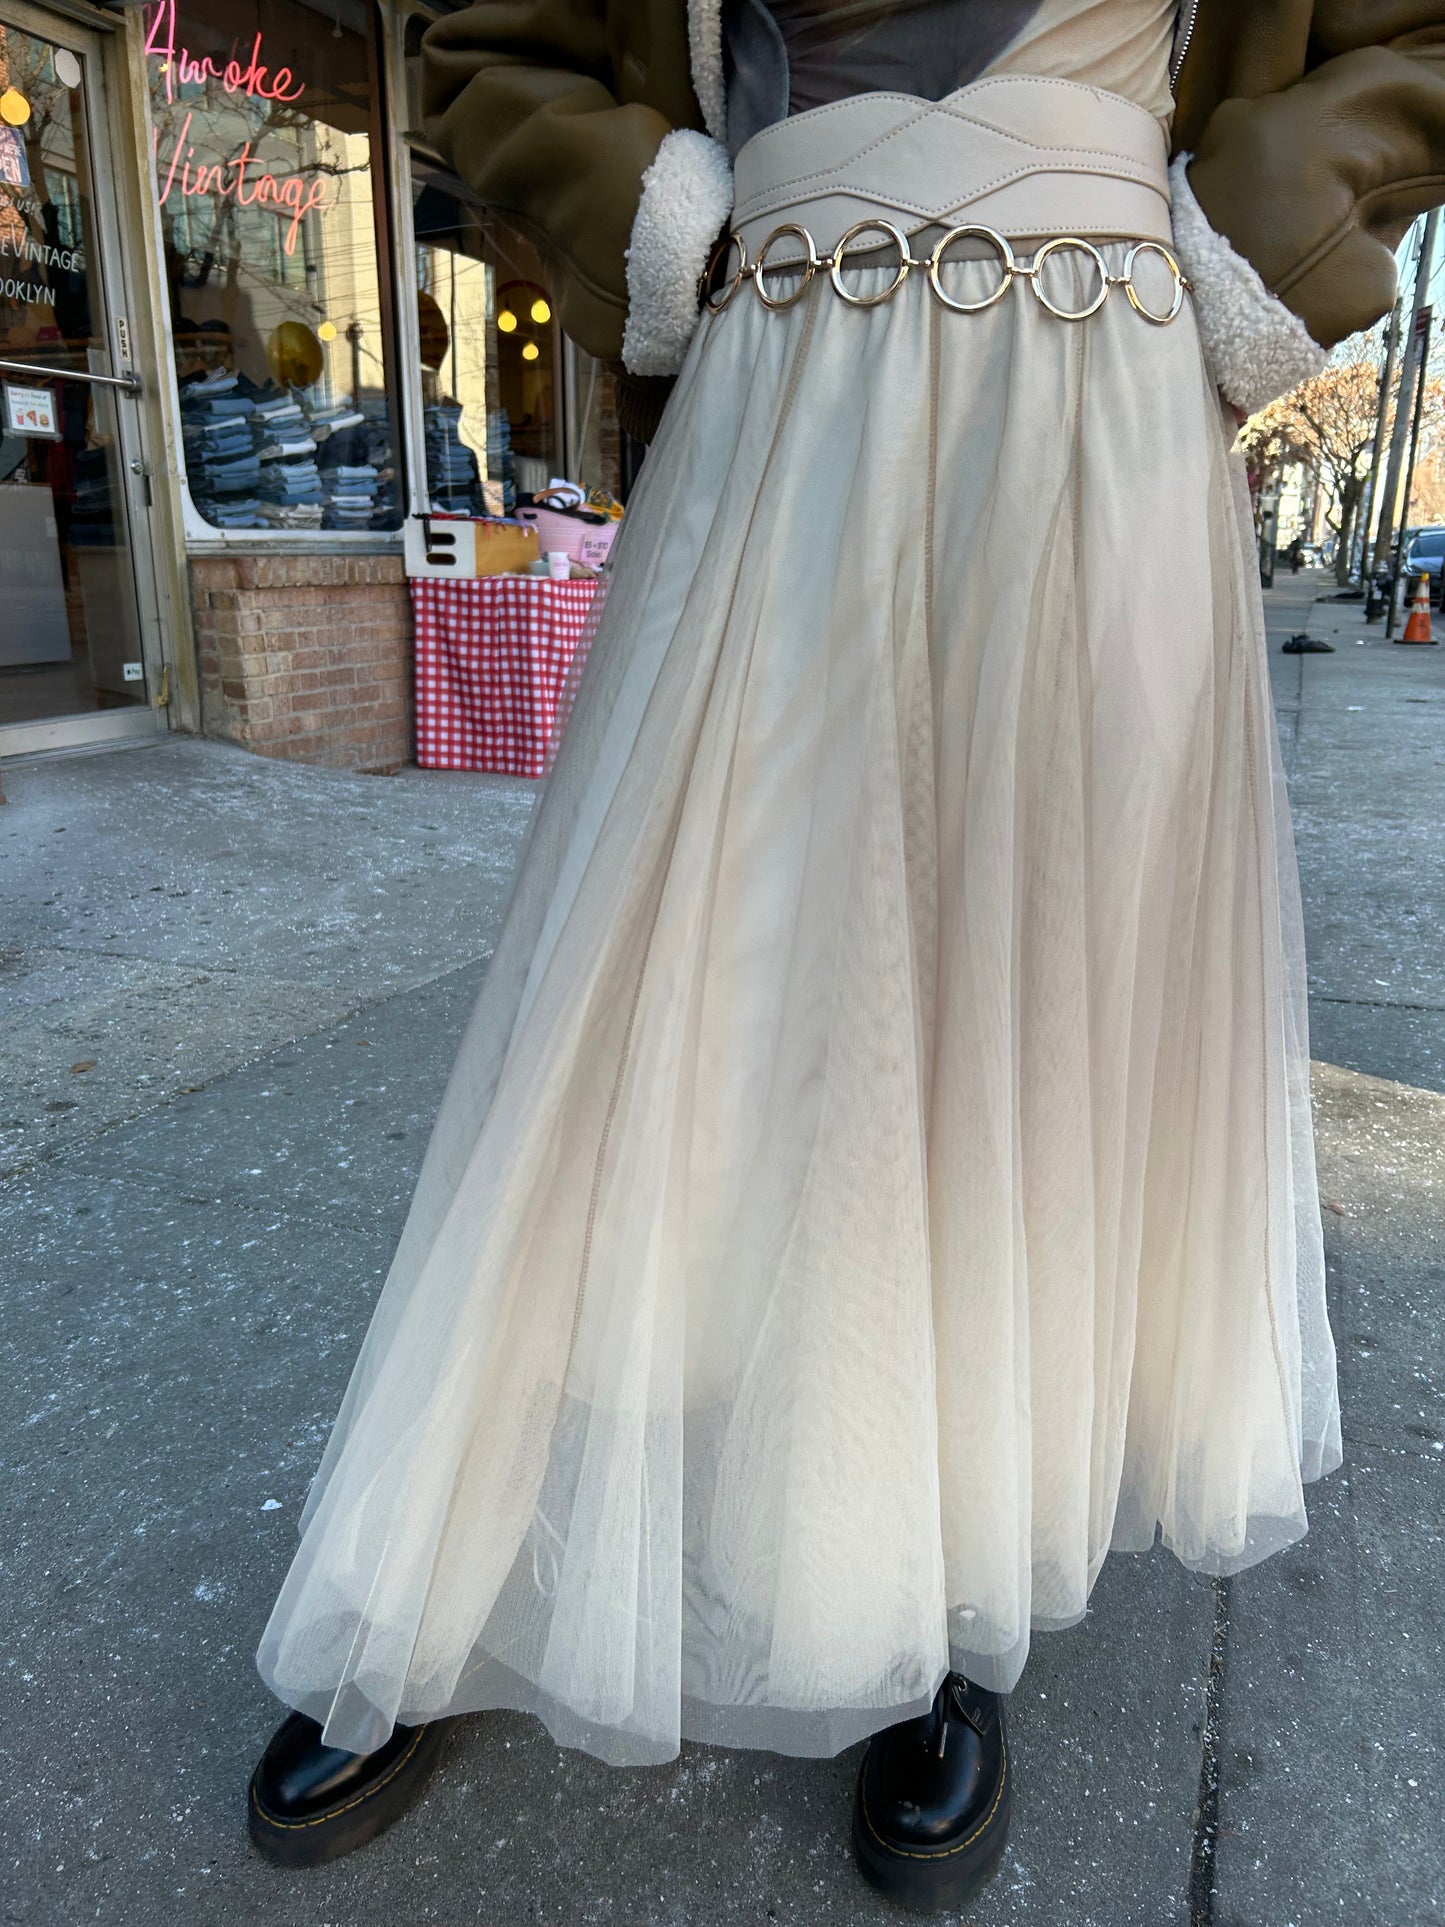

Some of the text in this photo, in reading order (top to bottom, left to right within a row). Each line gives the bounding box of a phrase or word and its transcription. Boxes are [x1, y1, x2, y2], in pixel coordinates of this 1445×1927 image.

[144, 0, 305, 104] Awoke
[152, 111, 337, 256] Vintage
[118, 319, 129, 358] PUSH
